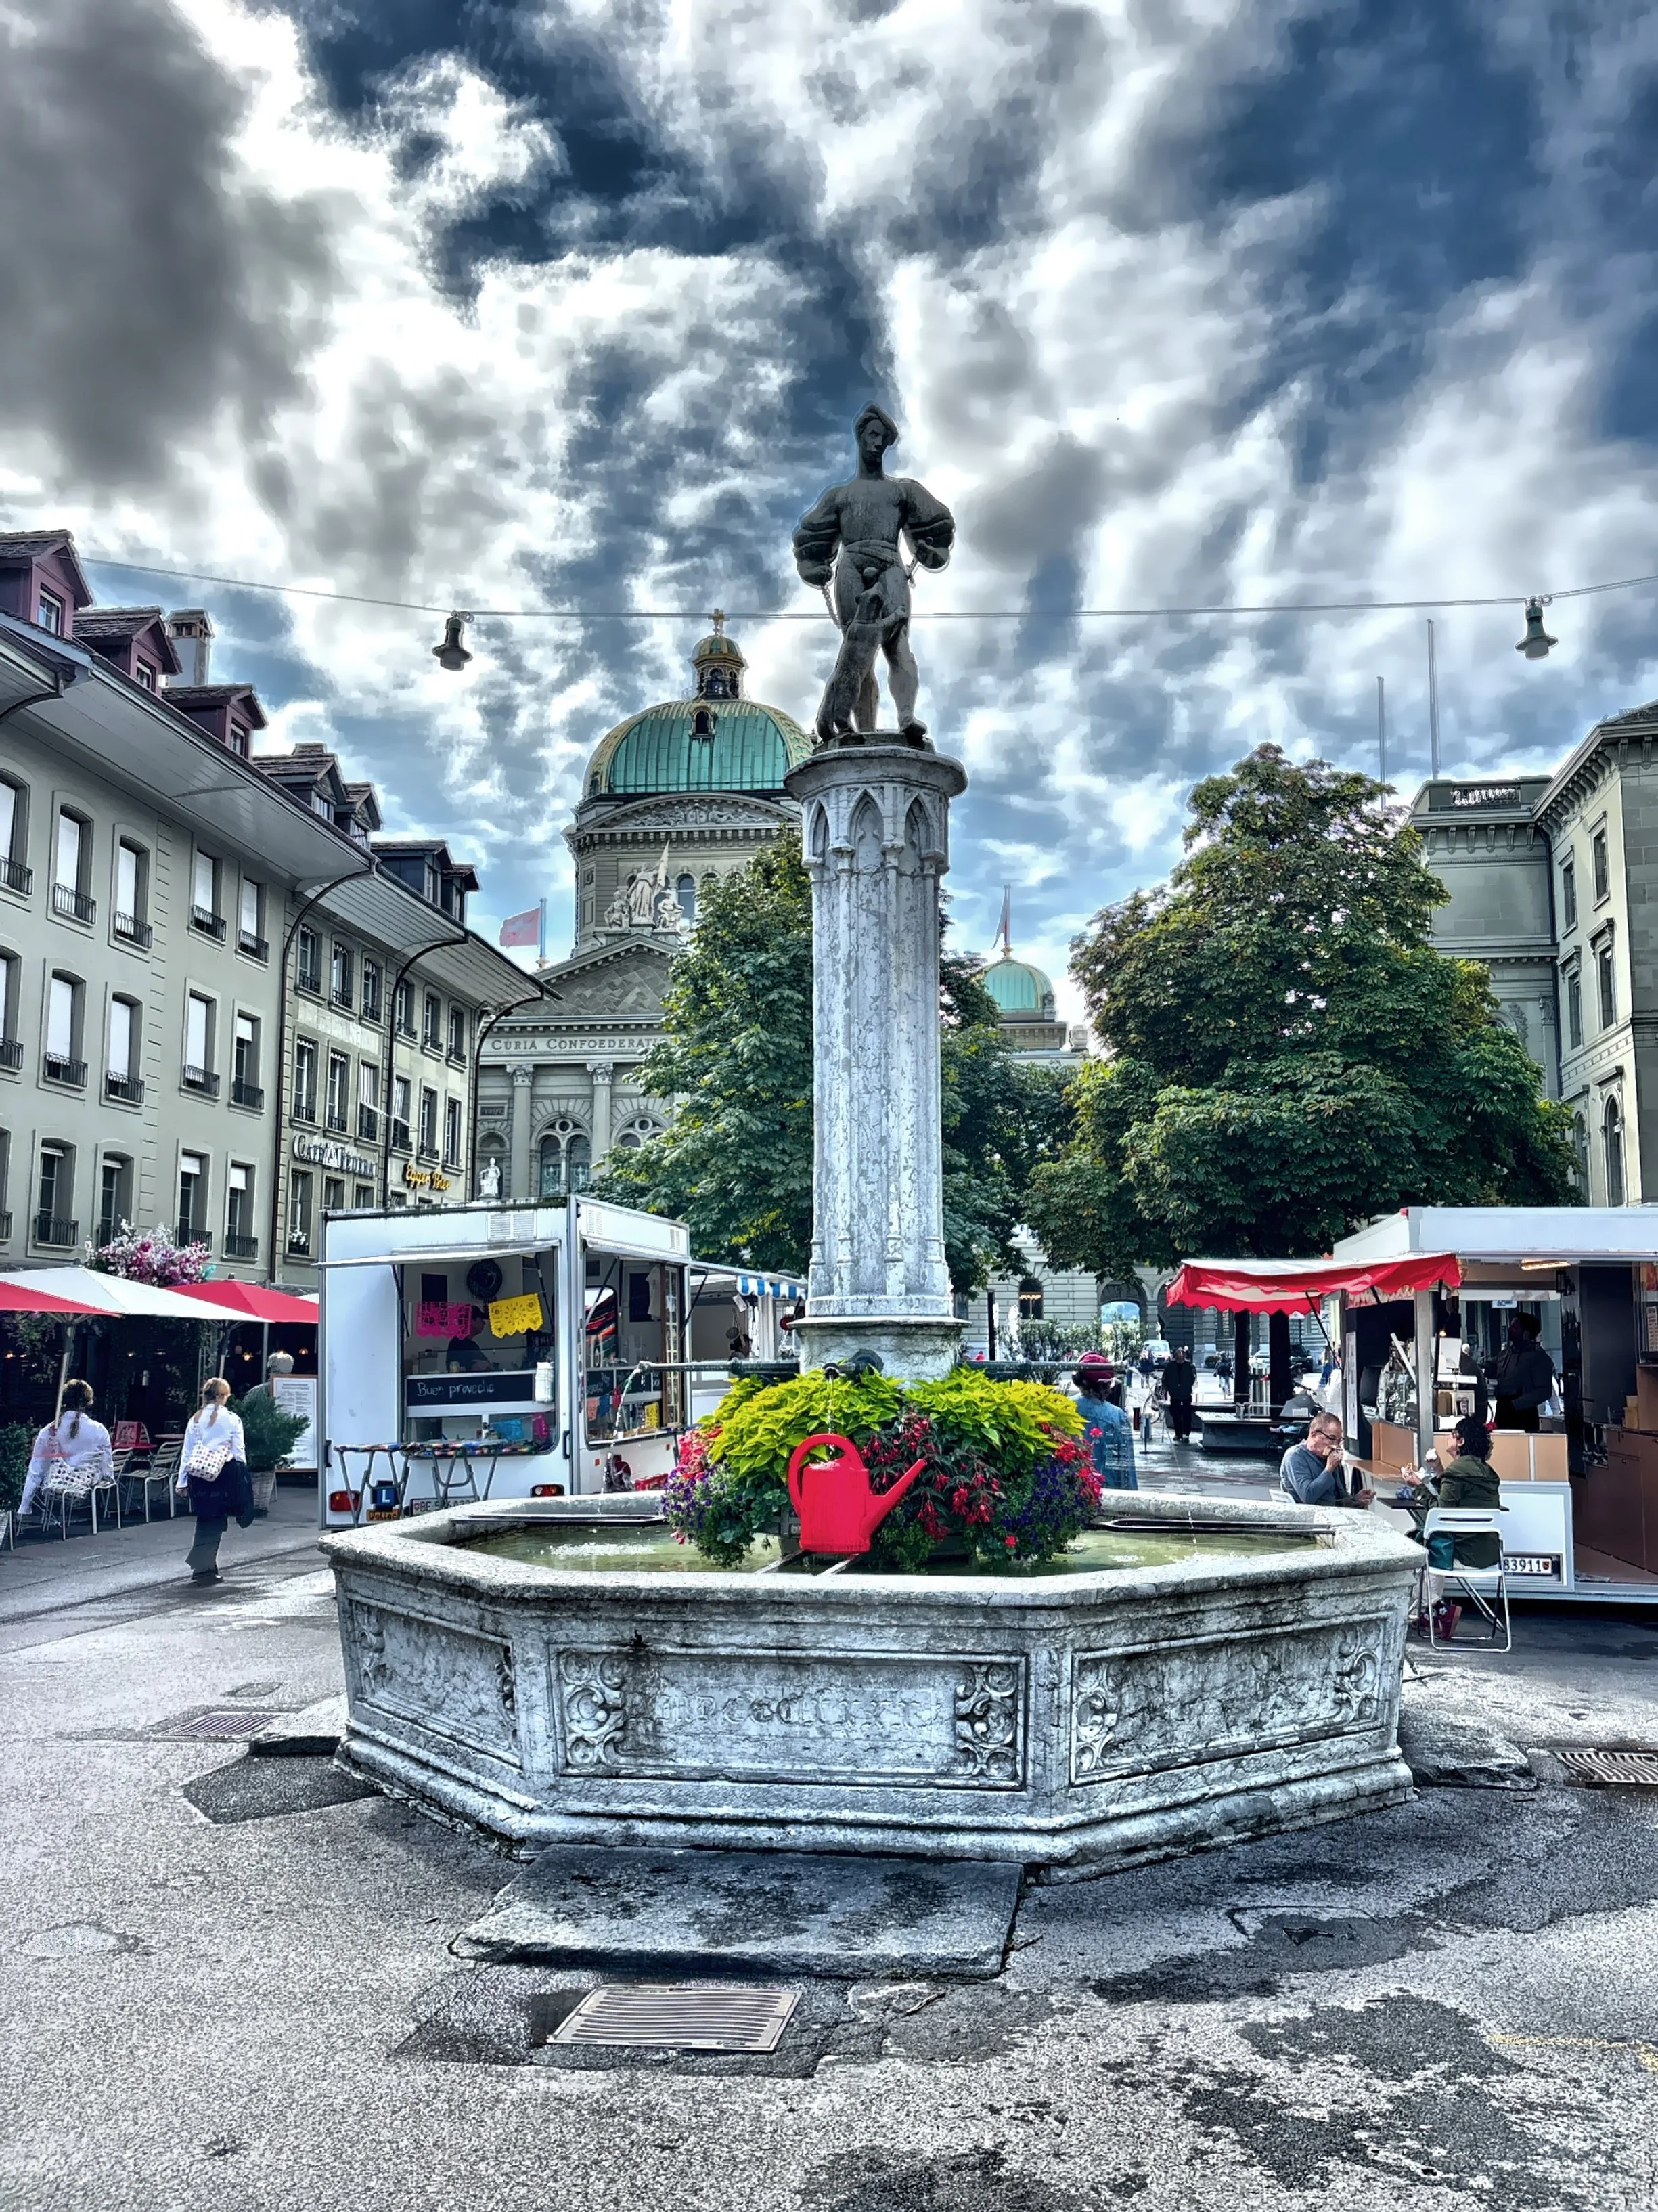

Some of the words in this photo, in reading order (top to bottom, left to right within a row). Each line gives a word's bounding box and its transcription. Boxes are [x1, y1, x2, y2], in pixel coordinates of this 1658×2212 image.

[491, 1039, 538, 1050] CURIA
[546, 1038, 668, 1049] CONFOEDERAT
[449, 1380, 495, 1399] provecho
[382, 1488, 390, 1503] L
[420, 1501, 431, 1512] BE
[1503, 1559, 1541, 1572] 83911
